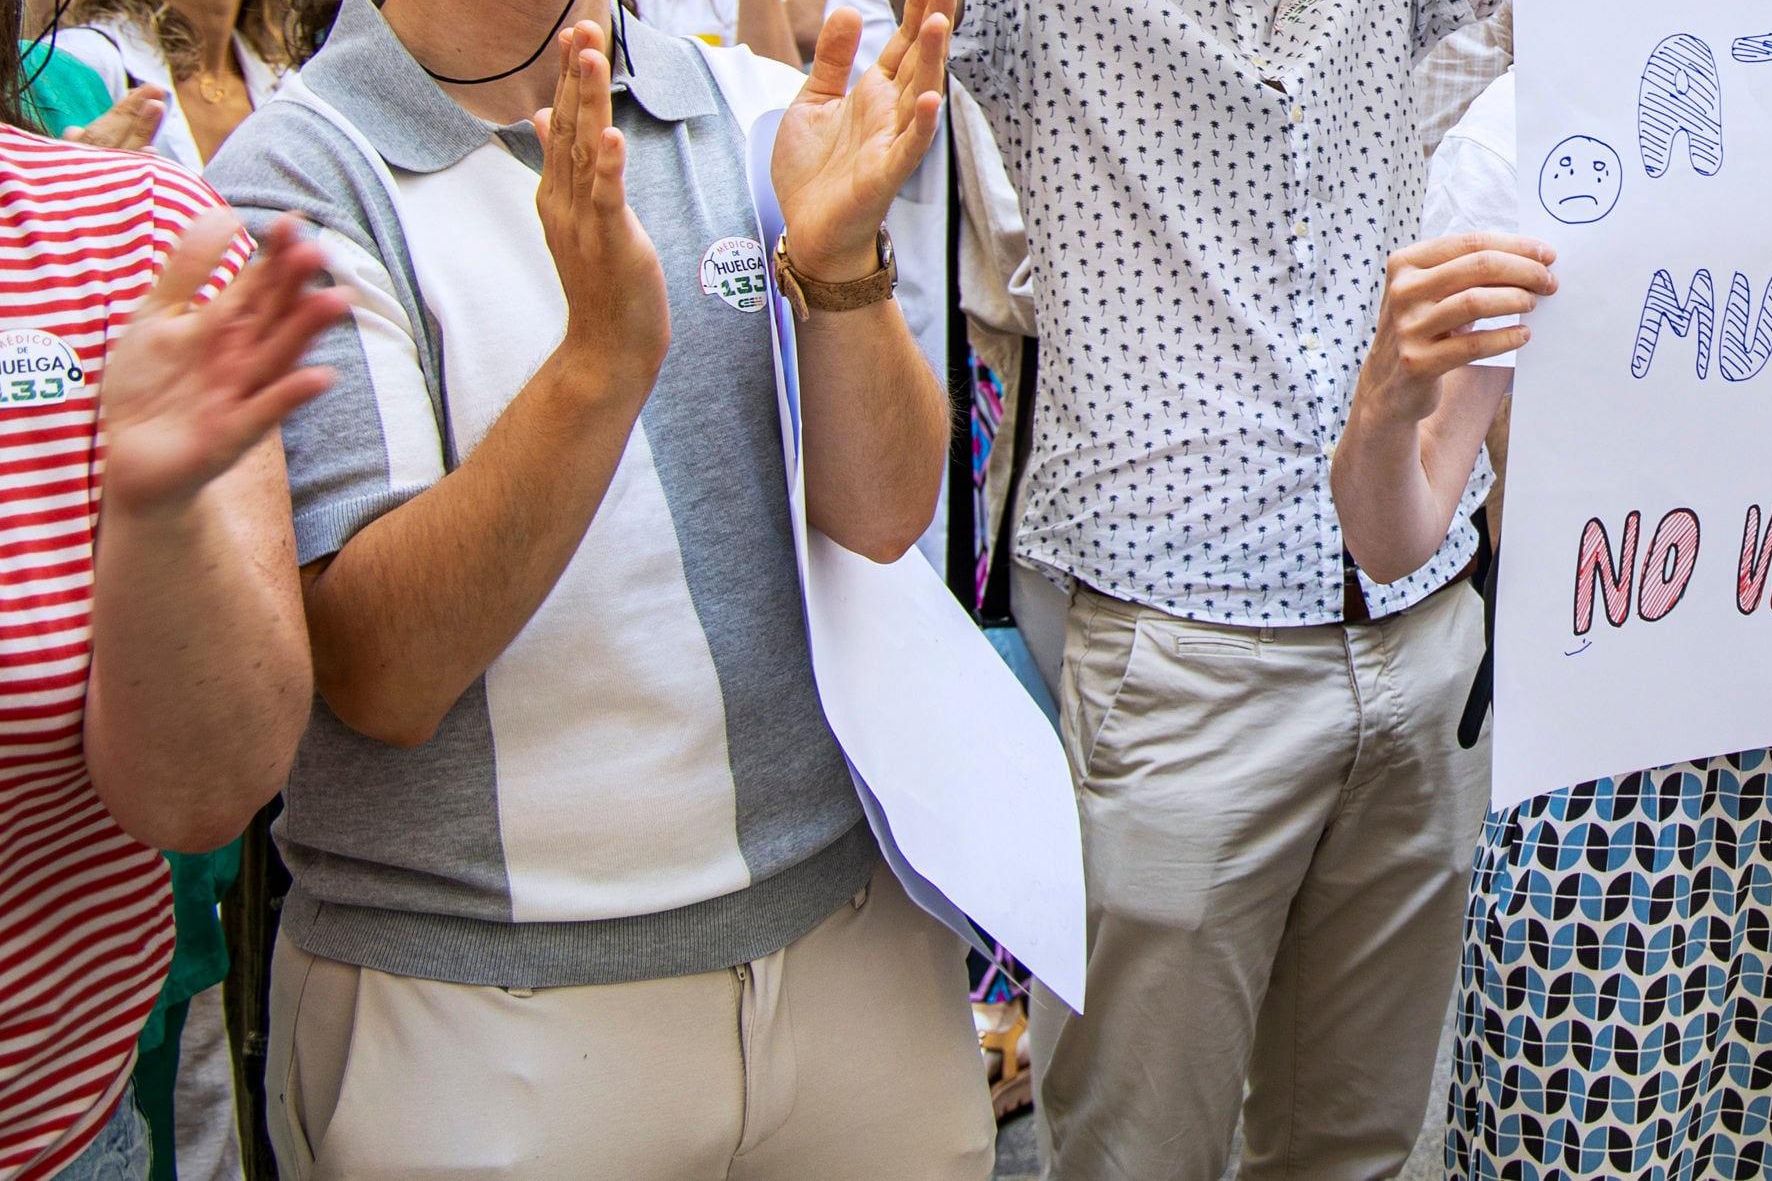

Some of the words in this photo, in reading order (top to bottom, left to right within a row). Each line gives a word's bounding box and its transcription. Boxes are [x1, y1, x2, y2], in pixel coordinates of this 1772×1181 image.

[716, 257, 765, 275] HUELGA
[721, 274, 767, 297] 13J
[17, 346, 29, 354] DE
[0, 355, 65, 375] UELGA
[1572, 507, 1702, 637] NO
